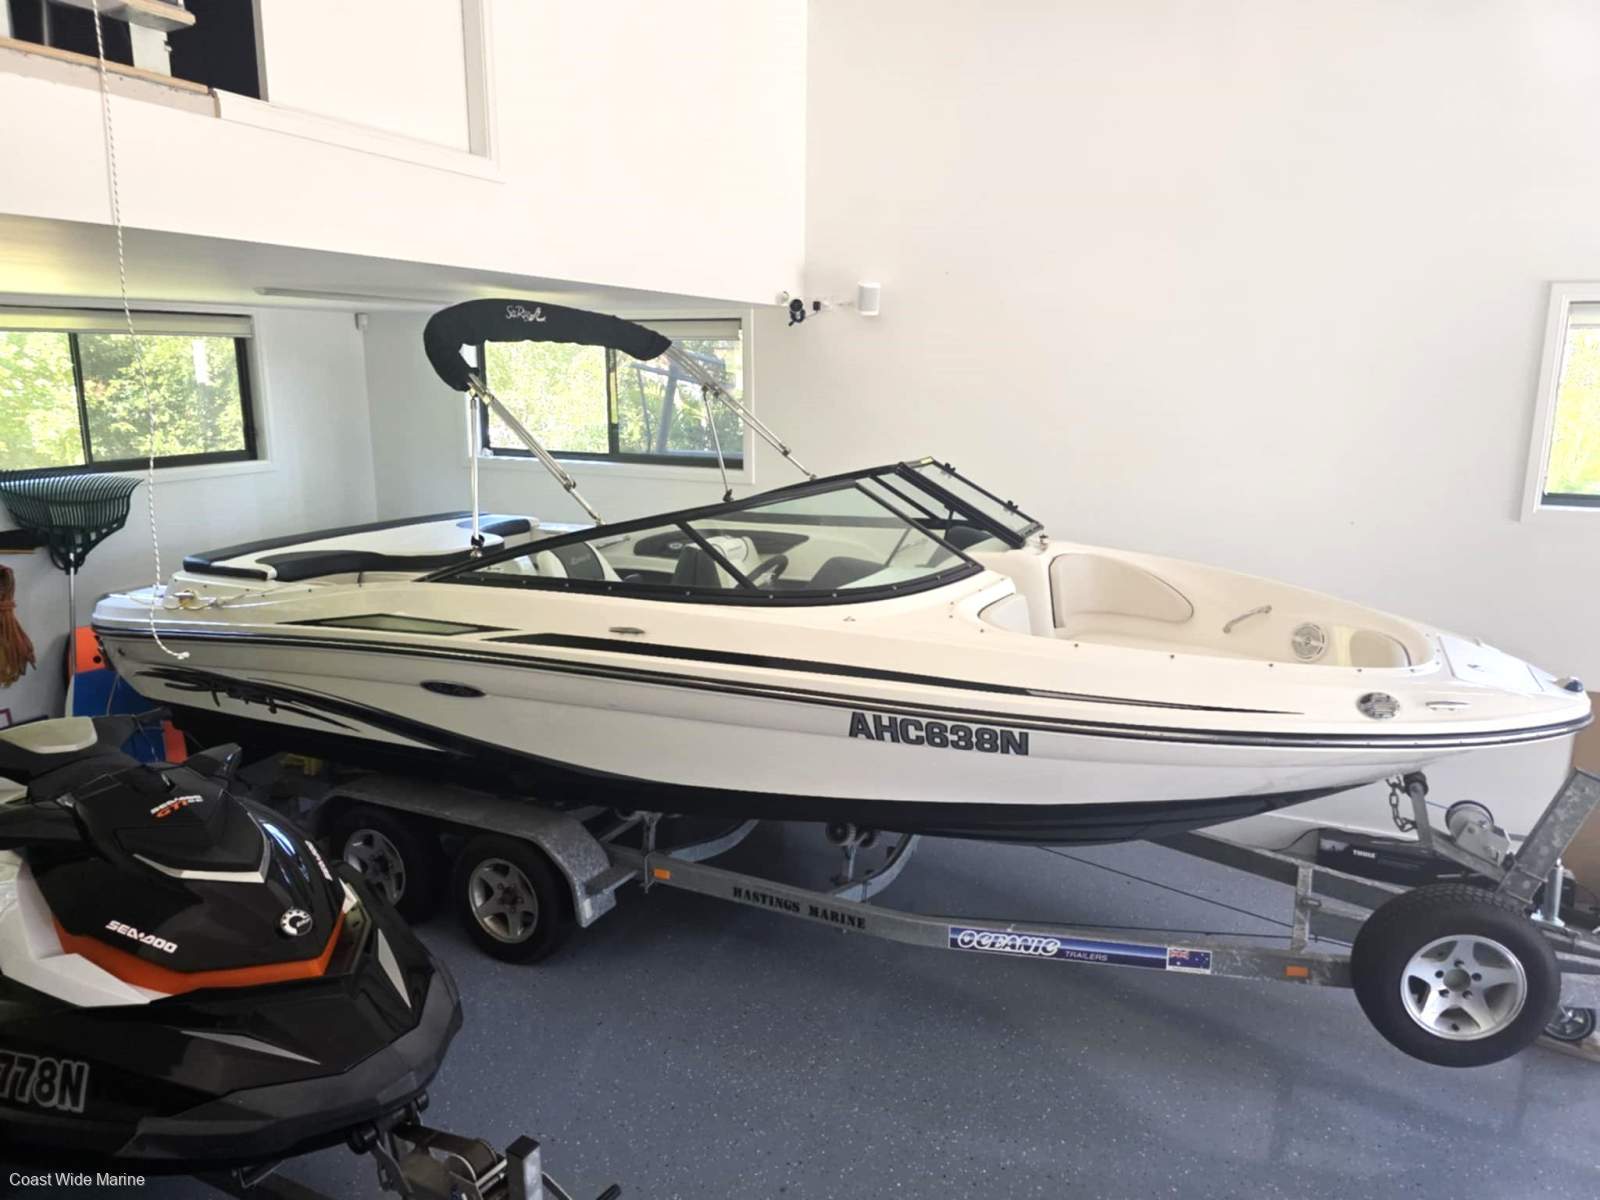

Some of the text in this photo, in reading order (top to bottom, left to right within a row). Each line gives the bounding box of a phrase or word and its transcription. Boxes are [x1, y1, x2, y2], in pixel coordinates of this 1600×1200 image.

[849, 712, 1029, 756] AHC638N
[733, 886, 866, 929] HASTINGS MARINE
[958, 930, 1108, 962] OCEANIC TRAILERS
